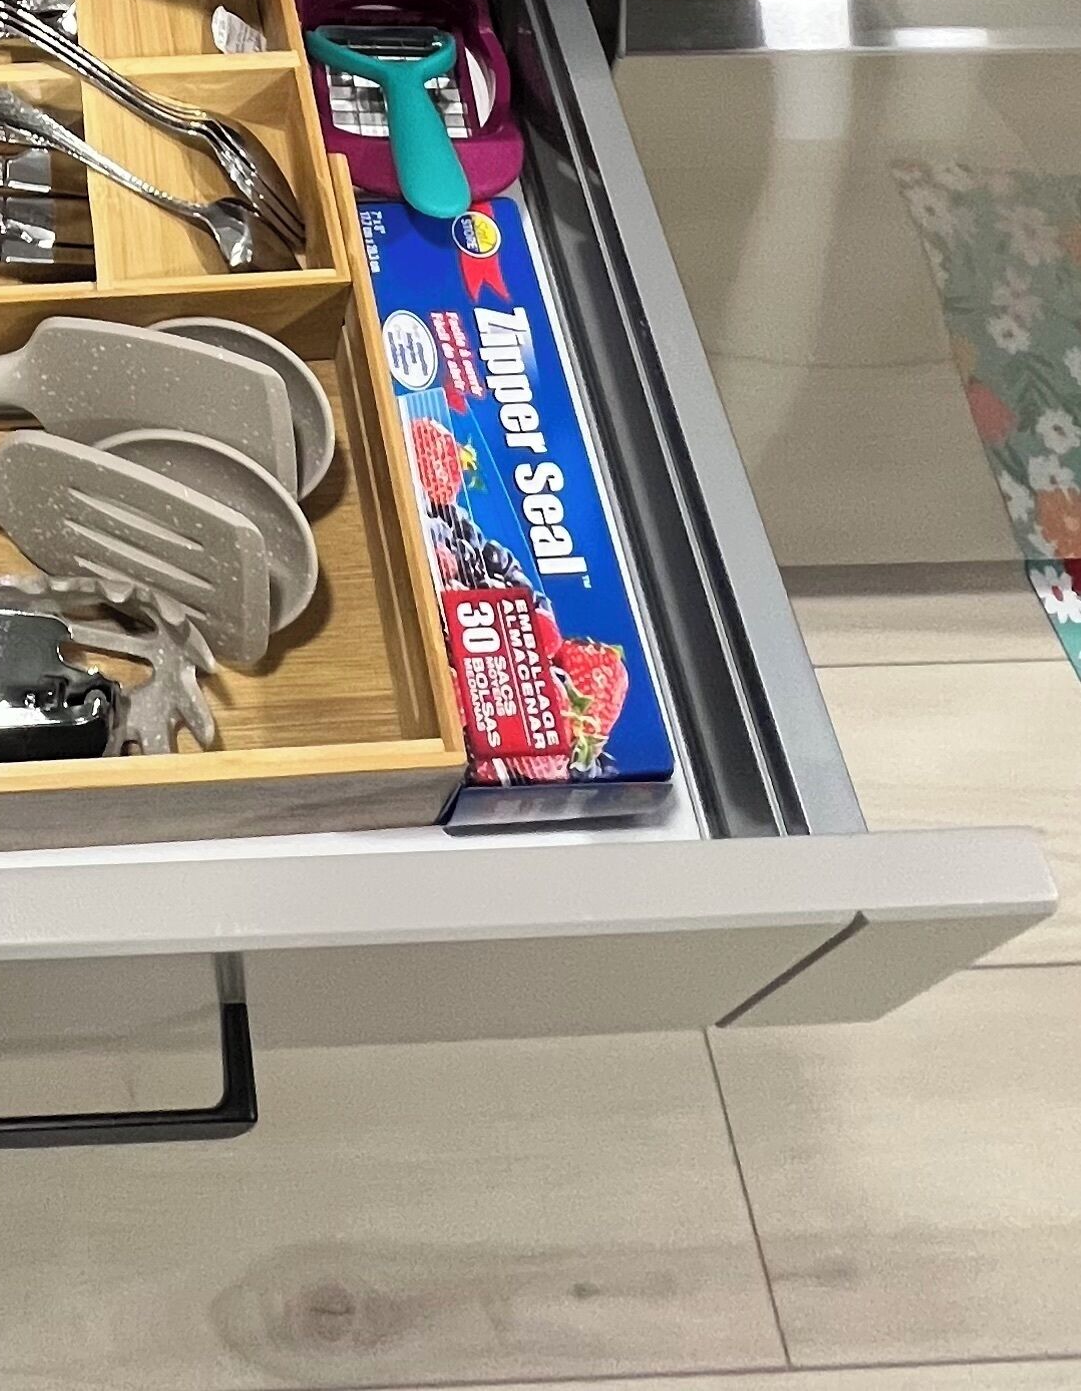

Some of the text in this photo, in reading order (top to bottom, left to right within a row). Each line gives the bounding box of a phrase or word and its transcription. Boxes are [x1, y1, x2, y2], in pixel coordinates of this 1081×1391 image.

[460, 218, 478, 251] STORE
[473, 306, 548, 454] Zipper
[513, 461, 588, 575] Seal
[456, 601, 501, 654] 30
[463, 657, 486, 732] MEDIANAS
[472, 657, 501, 748] BOLSAS
[485, 656, 506, 717] MOYENS
[495, 655, 517, 717] SACS
[502, 599, 546, 749] ALMACENAR
[514, 599, 560, 746] EMBALLAGE
